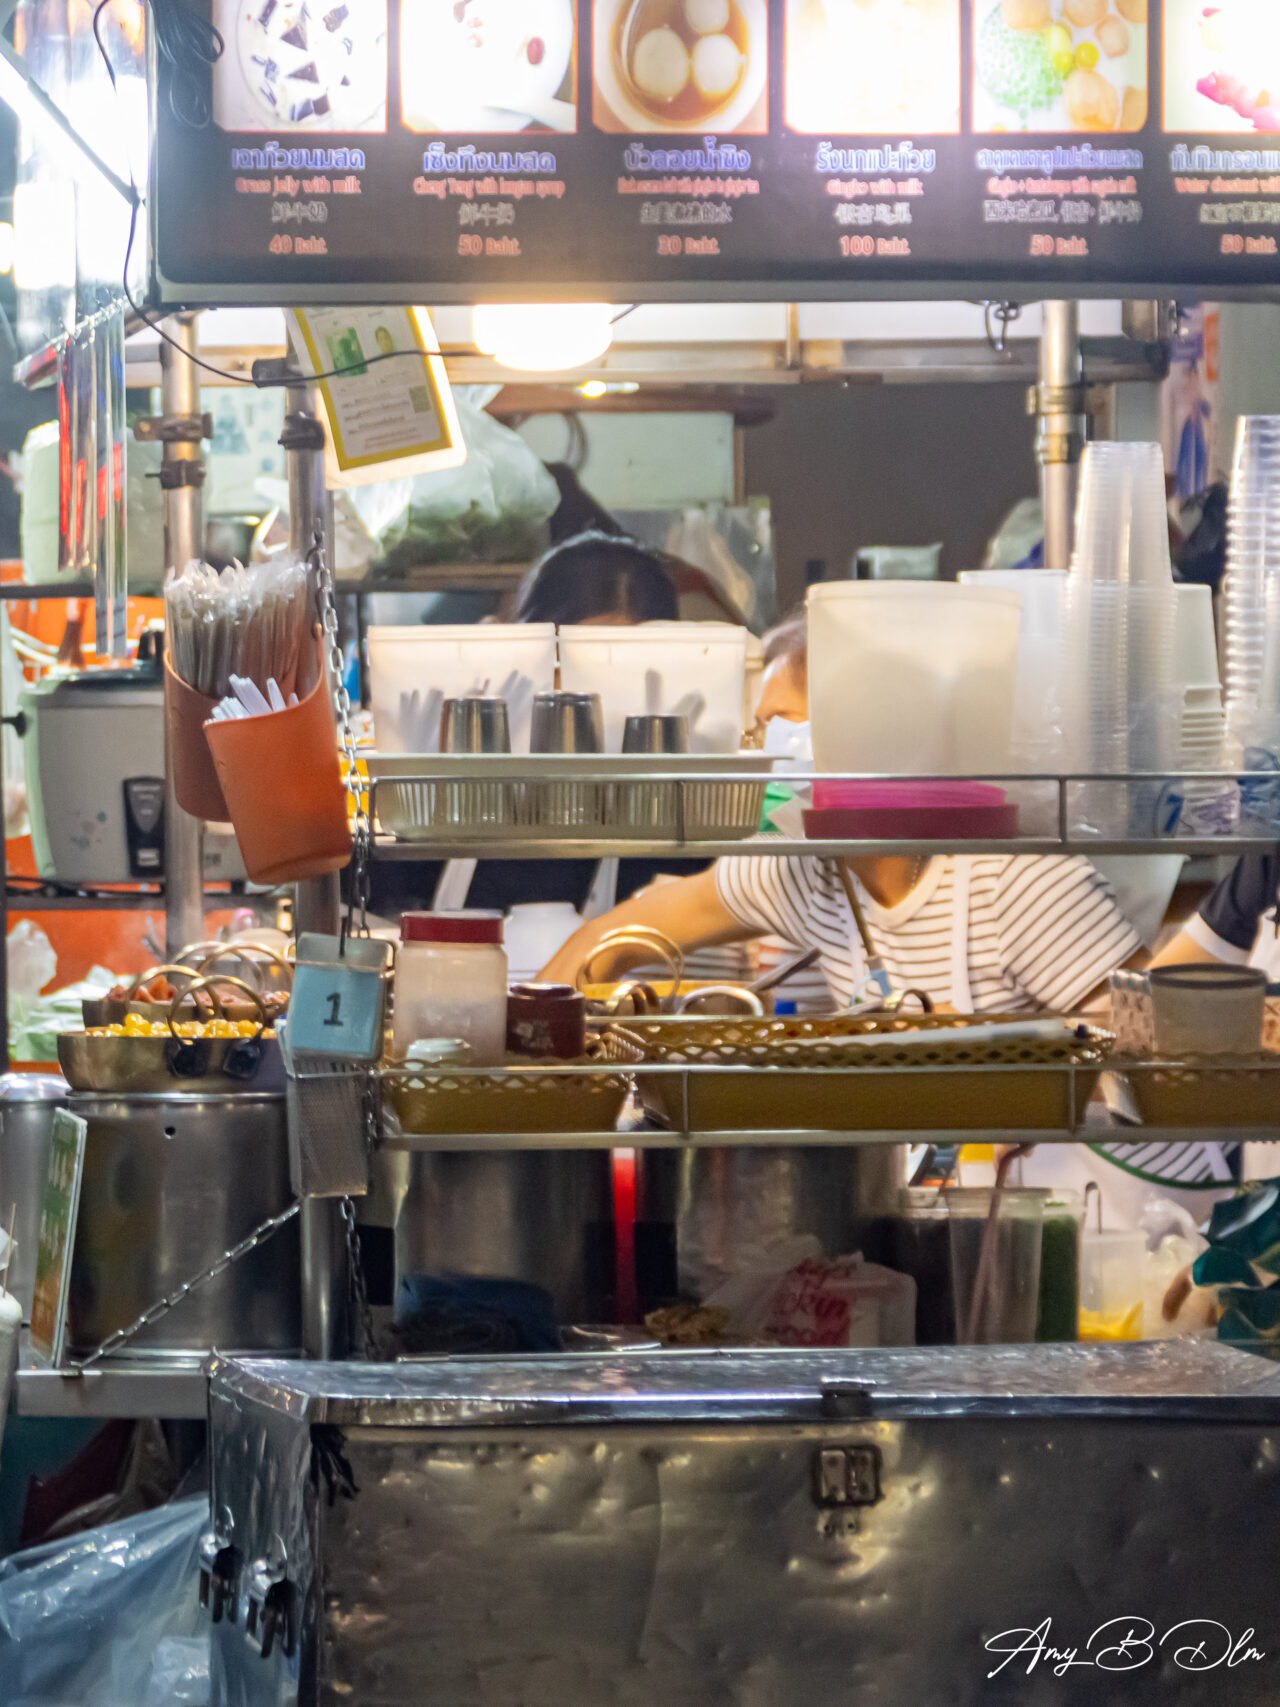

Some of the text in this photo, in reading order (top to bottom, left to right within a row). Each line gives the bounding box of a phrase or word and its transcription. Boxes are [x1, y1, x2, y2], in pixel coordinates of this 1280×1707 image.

[624, 136, 751, 171] บัวลอยน้ำขิง
[816, 141, 936, 173] รังนกแปะก๊วย
[302, 176, 331, 193] with
[332, 175, 362, 194] milk
[869, 177, 897, 195] with
[269, 234, 292, 255] 40
[458, 234, 482, 255] 50
[840, 235, 874, 256] 100
[1030, 234, 1054, 255] 50
[1221, 234, 1244, 254] 50
[323, 992, 344, 1027] 1
